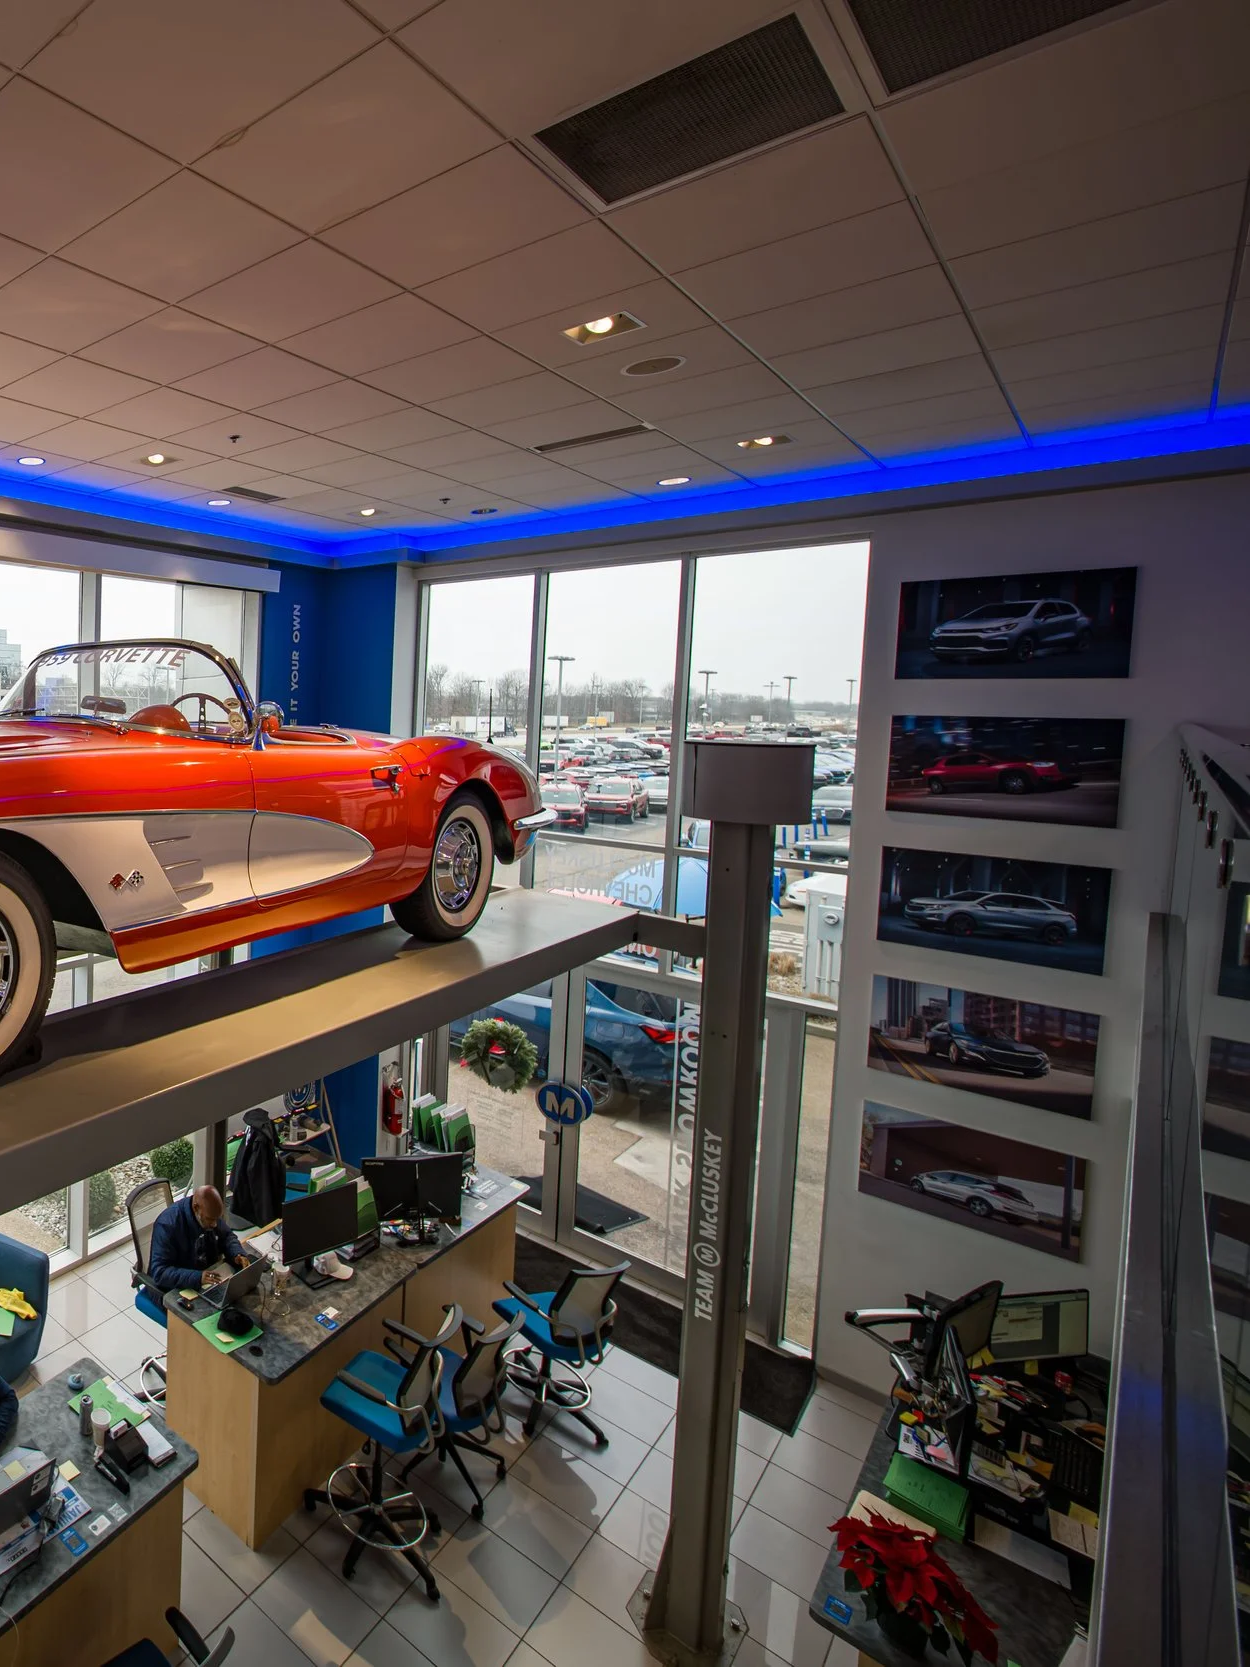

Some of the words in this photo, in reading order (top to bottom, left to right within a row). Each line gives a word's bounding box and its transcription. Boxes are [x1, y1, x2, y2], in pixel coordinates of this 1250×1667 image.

[292, 603, 302, 643] OWN
[72, 647, 190, 668] CORVETTE
[290, 650, 300, 692] YOUR
[289, 698, 299, 712] IT
[545, 1090, 575, 1120] M
[699, 1127, 723, 1241] McCLUSKEY
[694, 1268, 715, 1322] TEAM
